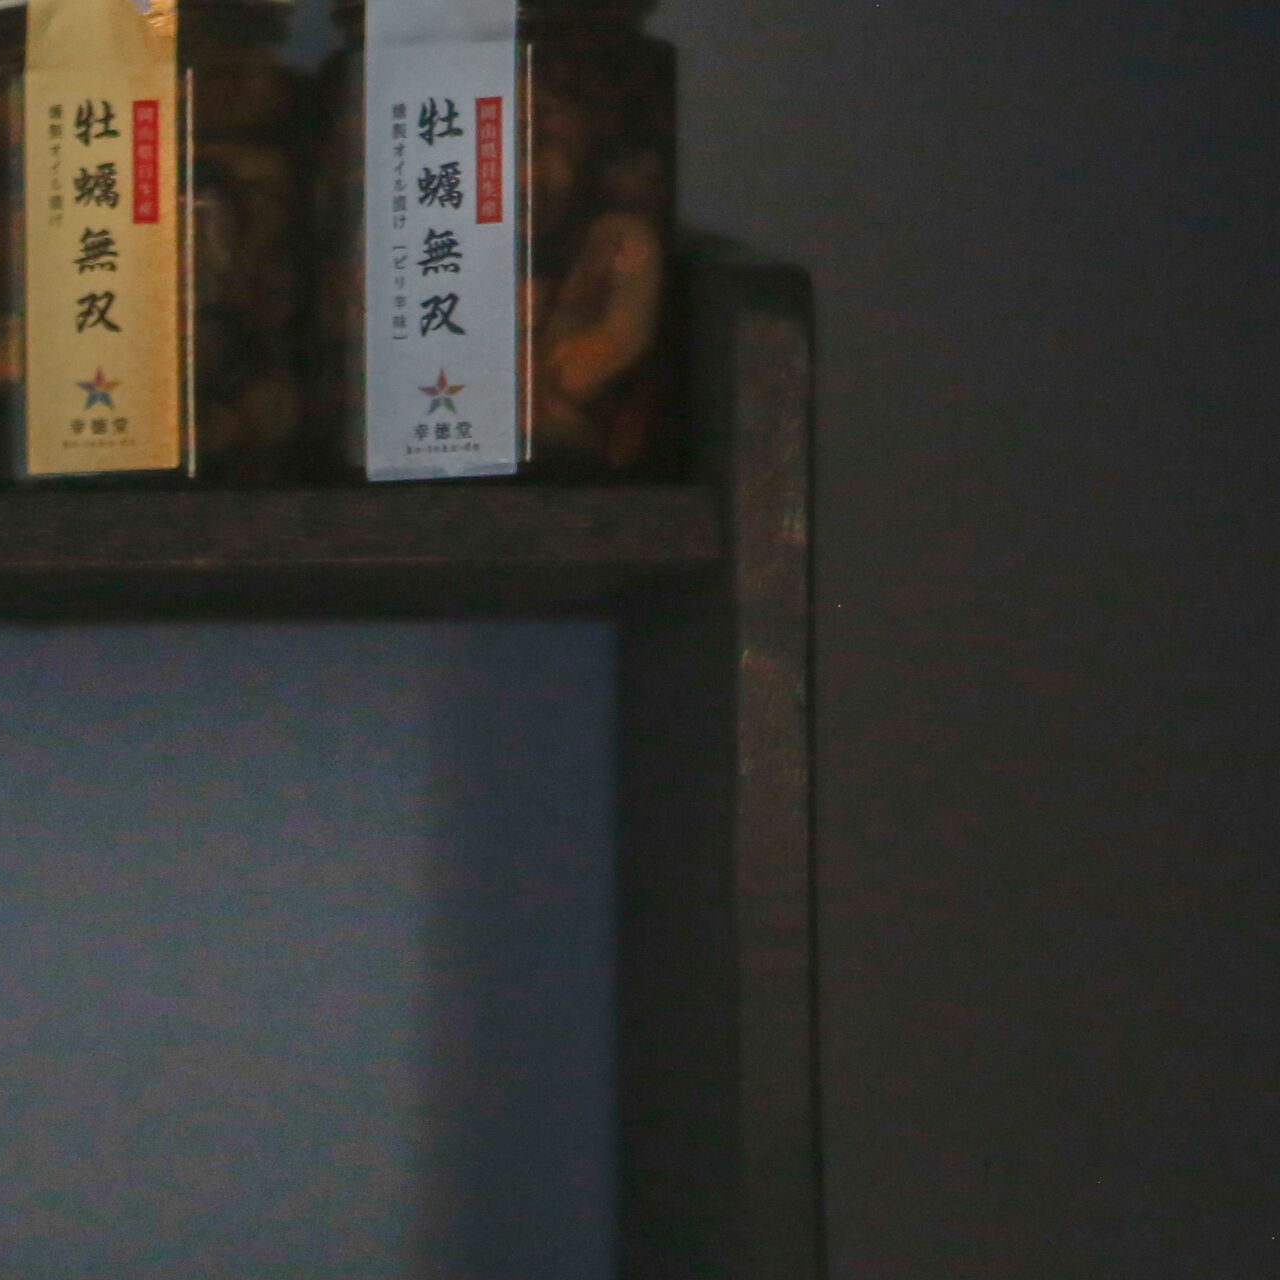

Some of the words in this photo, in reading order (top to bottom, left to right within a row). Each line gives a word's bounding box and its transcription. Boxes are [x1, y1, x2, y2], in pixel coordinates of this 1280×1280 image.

[73, 98, 123, 335] 牡蠣無双
[417, 97, 467, 337] 牡蠣無双
